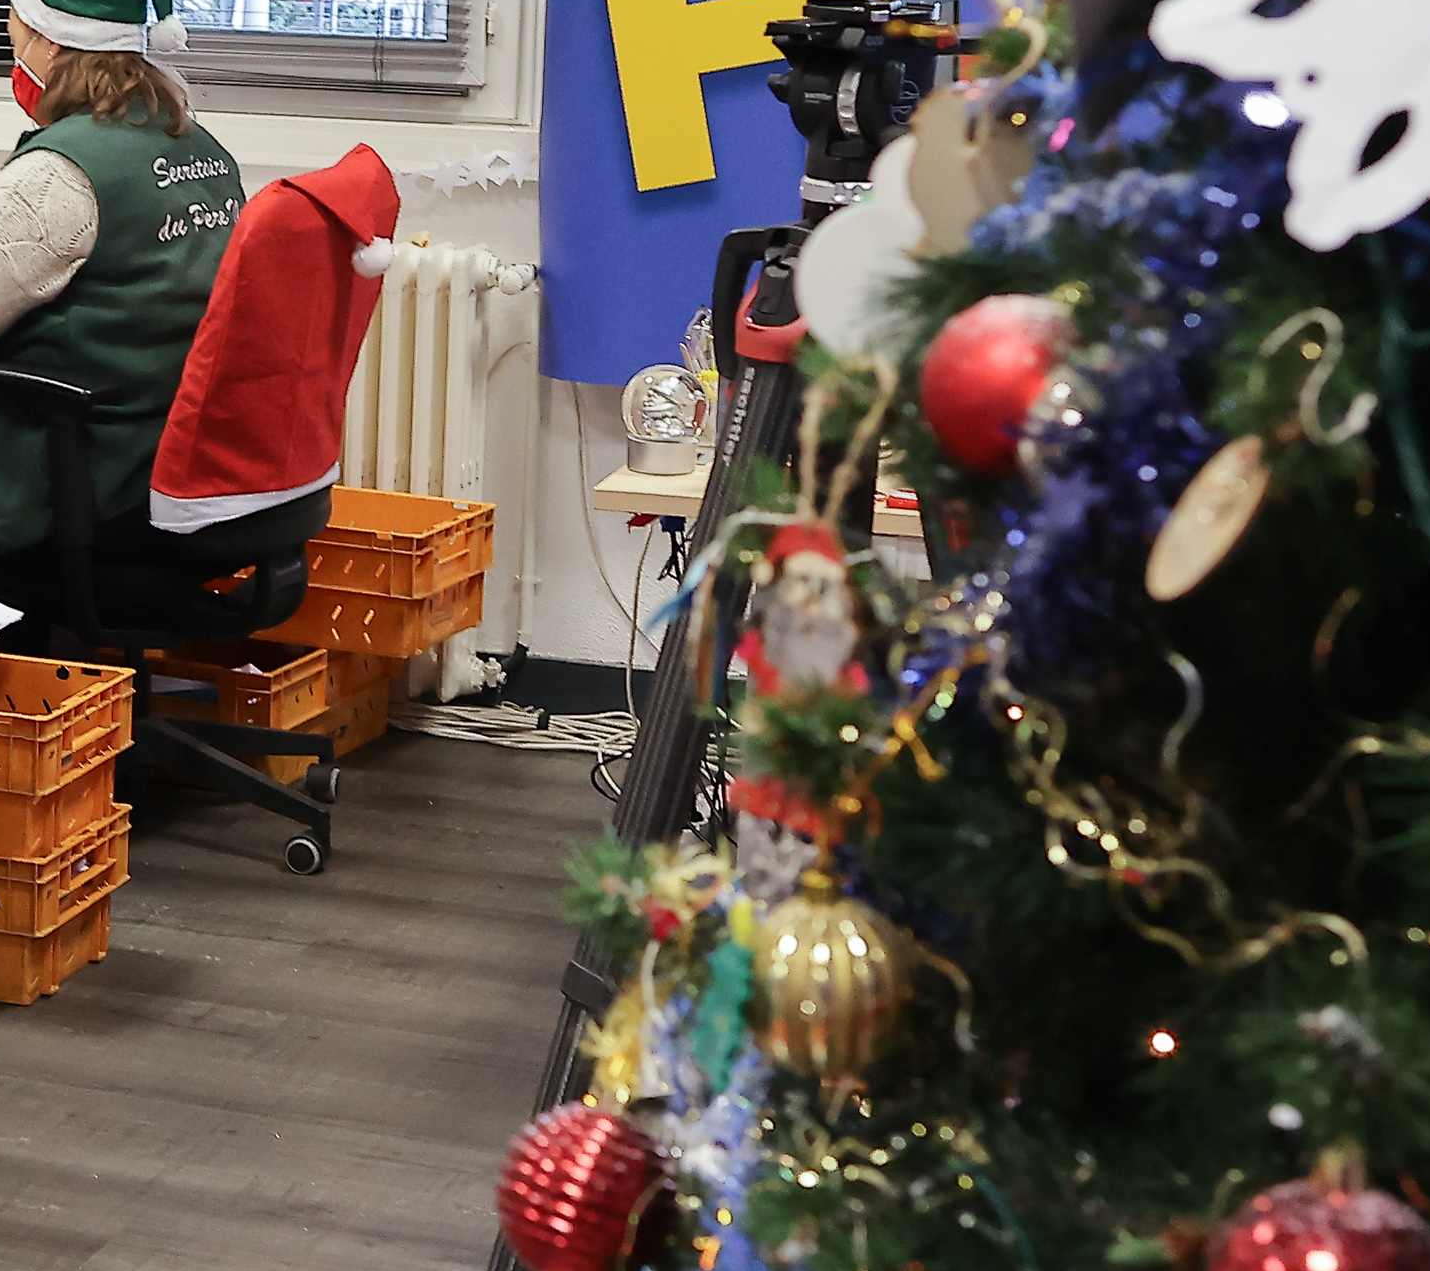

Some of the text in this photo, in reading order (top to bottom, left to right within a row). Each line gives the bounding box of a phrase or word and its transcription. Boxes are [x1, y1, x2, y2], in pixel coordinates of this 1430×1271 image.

[152, 154, 230, 188] Secrétaire
[157, 213, 190, 242] du
[186, 201, 230, 233] Père
